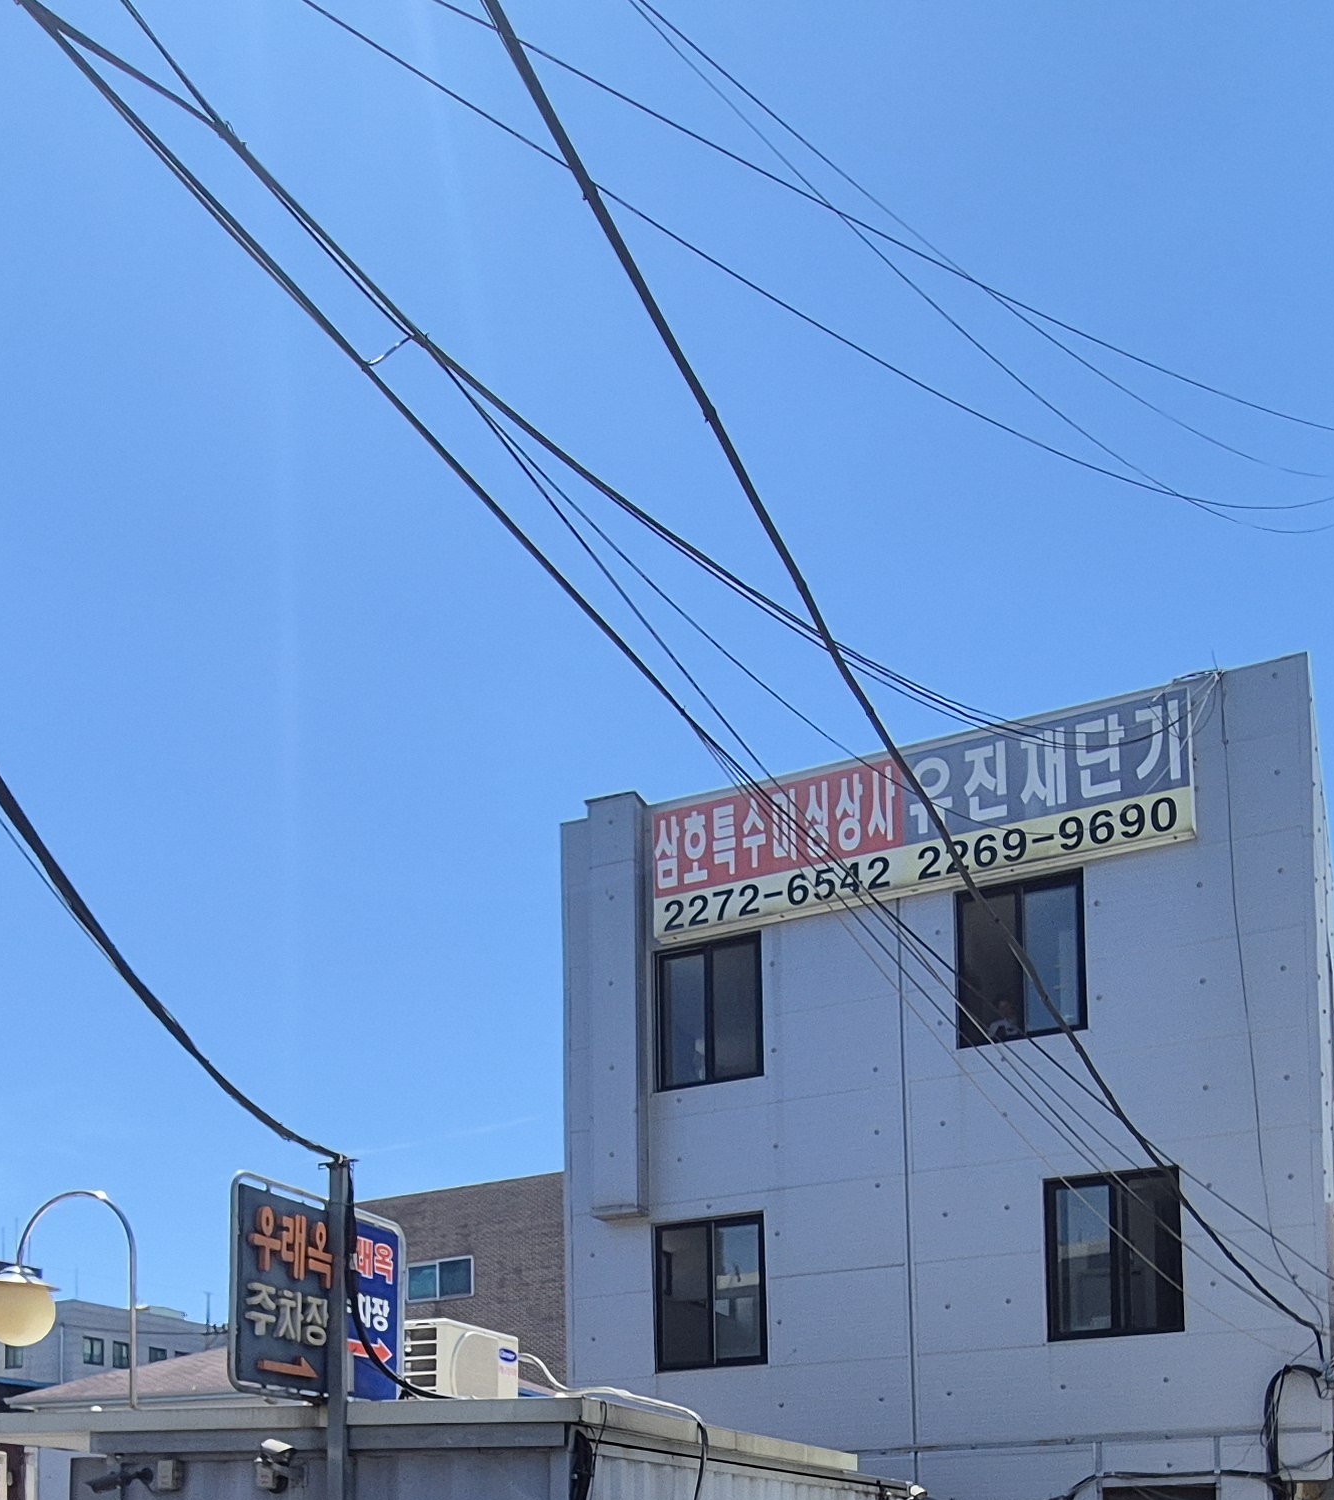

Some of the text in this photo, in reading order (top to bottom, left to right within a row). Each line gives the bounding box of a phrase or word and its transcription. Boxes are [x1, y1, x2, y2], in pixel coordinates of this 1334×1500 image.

[653, 699, 1183, 890] 삼호특수미싱상사 유진재단기
[663, 797, 1178, 932] 2272-6542 2269-9690
[249, 1205, 334, 1290] 우래옥
[245, 1282, 330, 1346] 주차장
